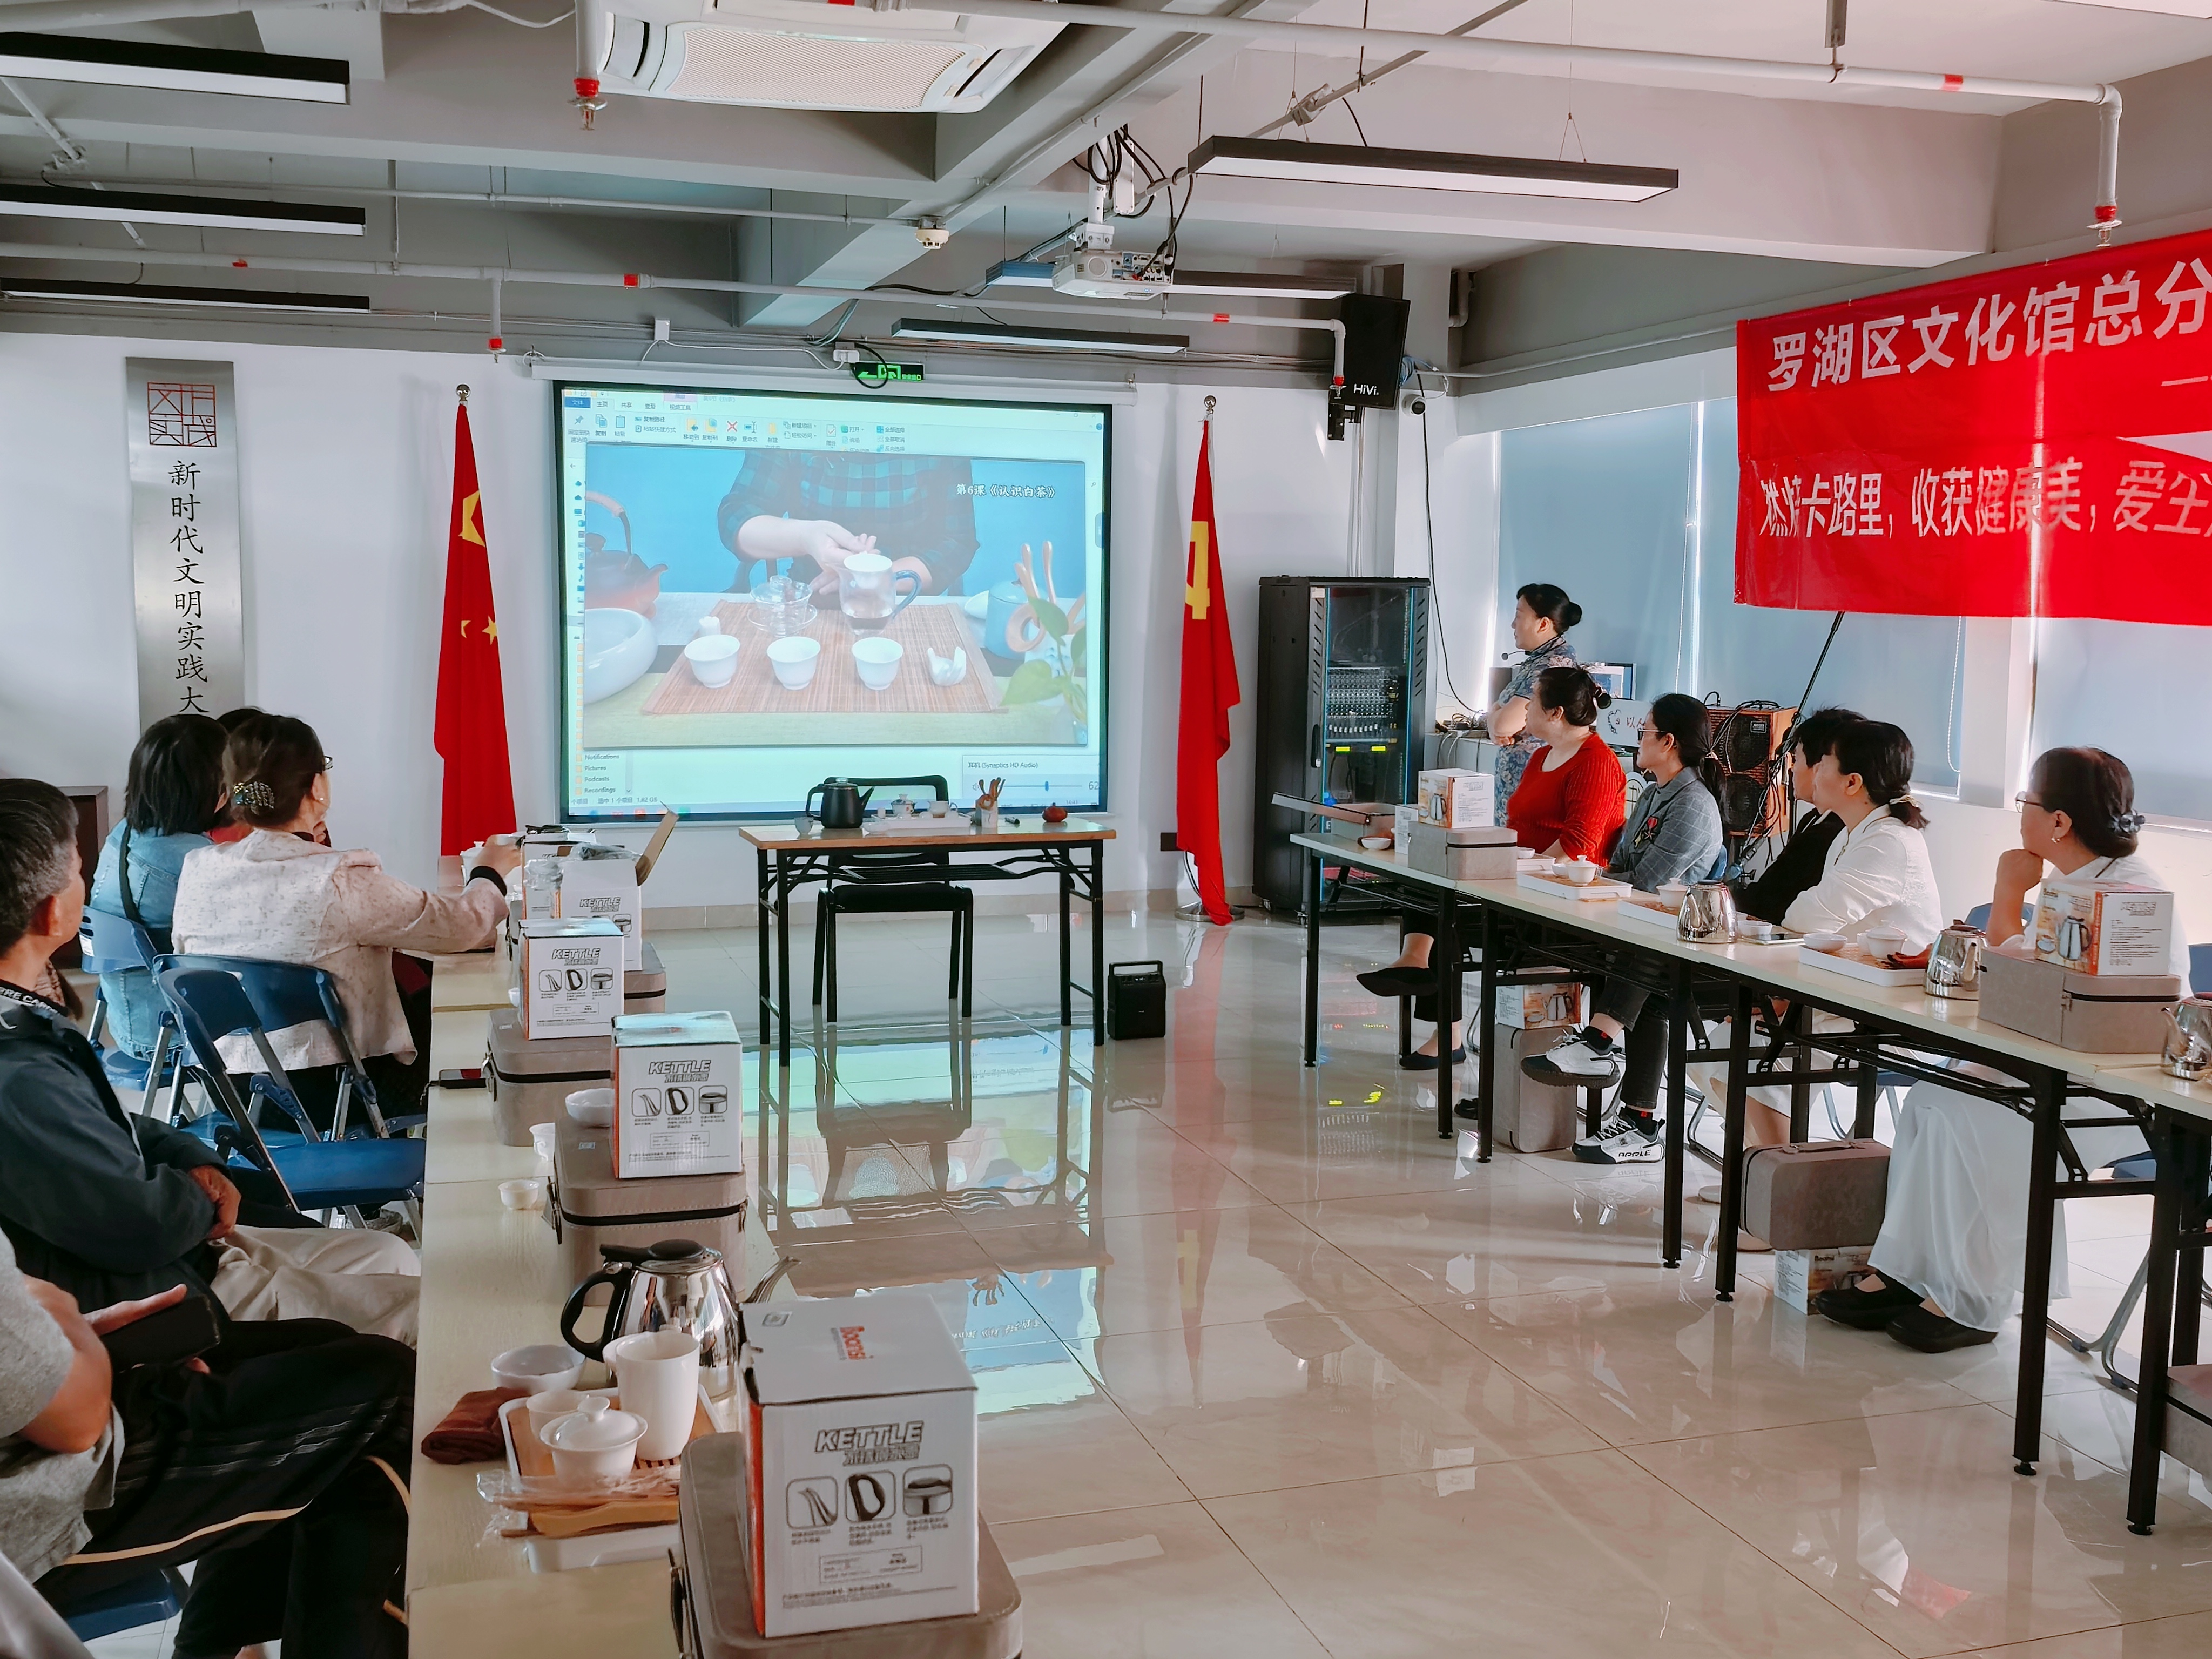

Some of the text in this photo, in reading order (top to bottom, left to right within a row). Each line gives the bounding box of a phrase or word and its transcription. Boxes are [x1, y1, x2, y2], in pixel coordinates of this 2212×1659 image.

[1768, 258, 2212, 392] 罗湖区文化馆总分
[168, 460, 209, 713] 新时代文明实践大
[579, 897, 621, 908] KETTLE
[552, 948, 601, 960] KETTLE
[649, 1060, 711, 1075] KETTLE
[814, 1420, 924, 1453] KETTLE
